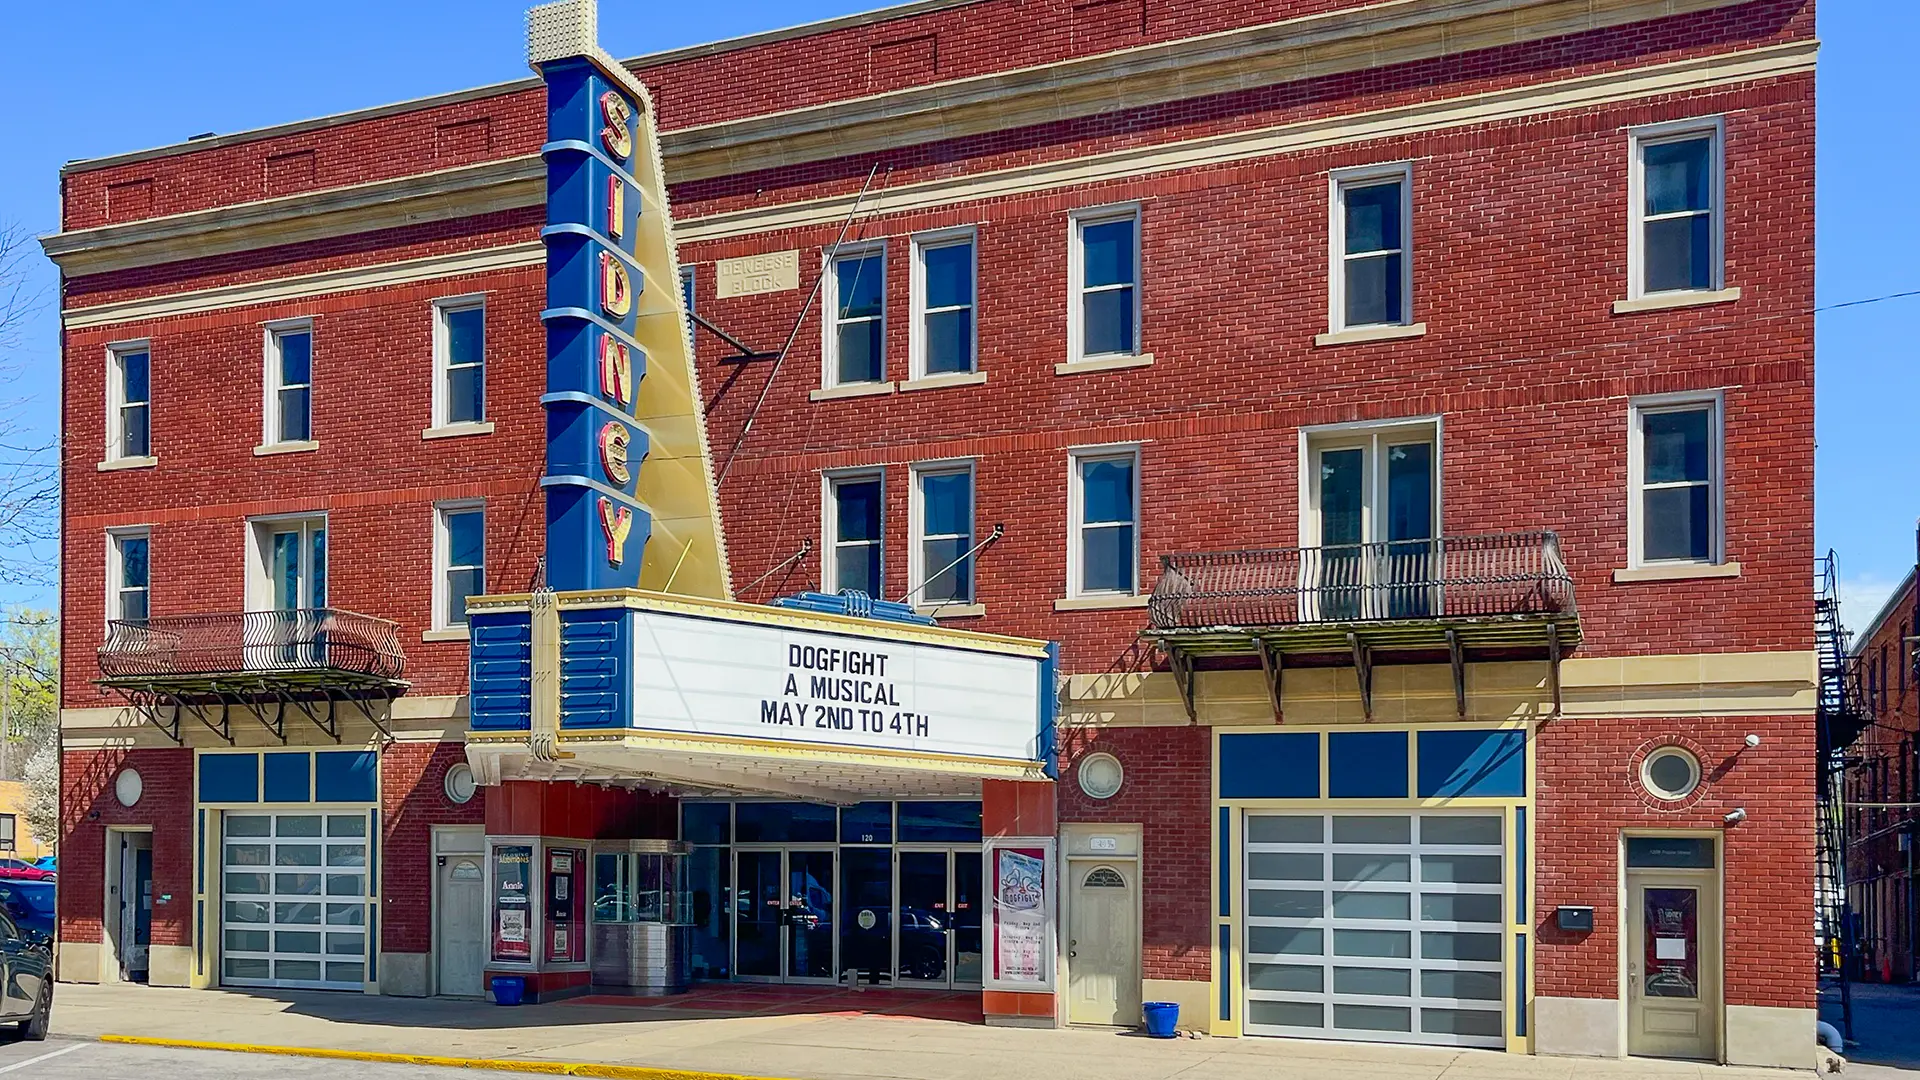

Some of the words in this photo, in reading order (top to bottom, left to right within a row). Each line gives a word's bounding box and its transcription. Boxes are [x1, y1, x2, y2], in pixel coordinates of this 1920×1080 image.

[722, 254, 793, 276] DEWEESE
[732, 276, 781, 294] BLOCK
[598, 90, 633, 567] SIDNEY
[789, 644, 888, 677] DOGFIGHT
[784, 673, 798, 697] A
[810, 676, 900, 707] MUSICAL
[761, 700, 808, 727] MAY
[815, 705, 853, 730] 2ND
[858, 709, 884, 733] TO
[889, 712, 929, 738] 4TH
[861, 834, 873, 842] 120
